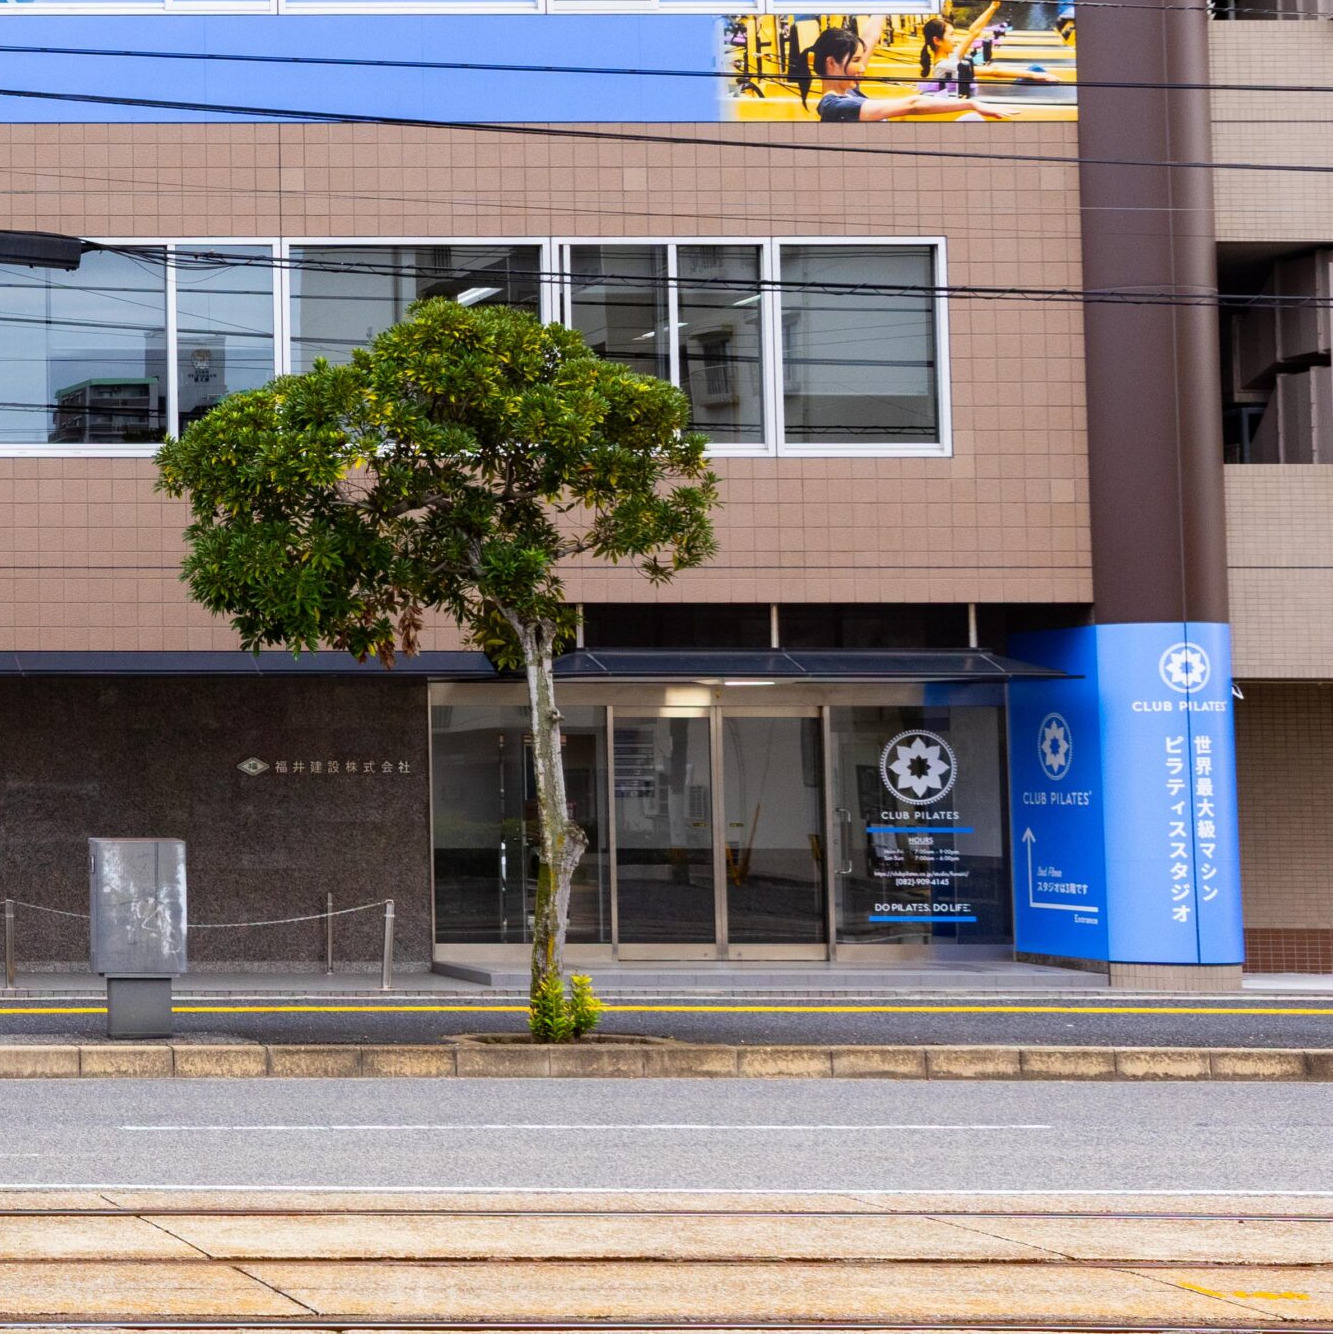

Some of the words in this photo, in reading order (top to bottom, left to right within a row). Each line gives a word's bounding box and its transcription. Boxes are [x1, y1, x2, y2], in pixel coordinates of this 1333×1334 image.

[1132, 700, 1173, 713] CLUB
[275, 760, 411, 775] 福井建設株式会社
[1022, 792, 1047, 805] CLUB
[880, 811, 910, 820] CLUB
[914, 811, 960, 820] PILATES
[1194, 735, 1219, 902] 世界最大級マシン
[1165, 735, 1191, 923] ピラティススタジオ
[874, 903, 890, 912] DO
[933, 903, 948, 912] DO
